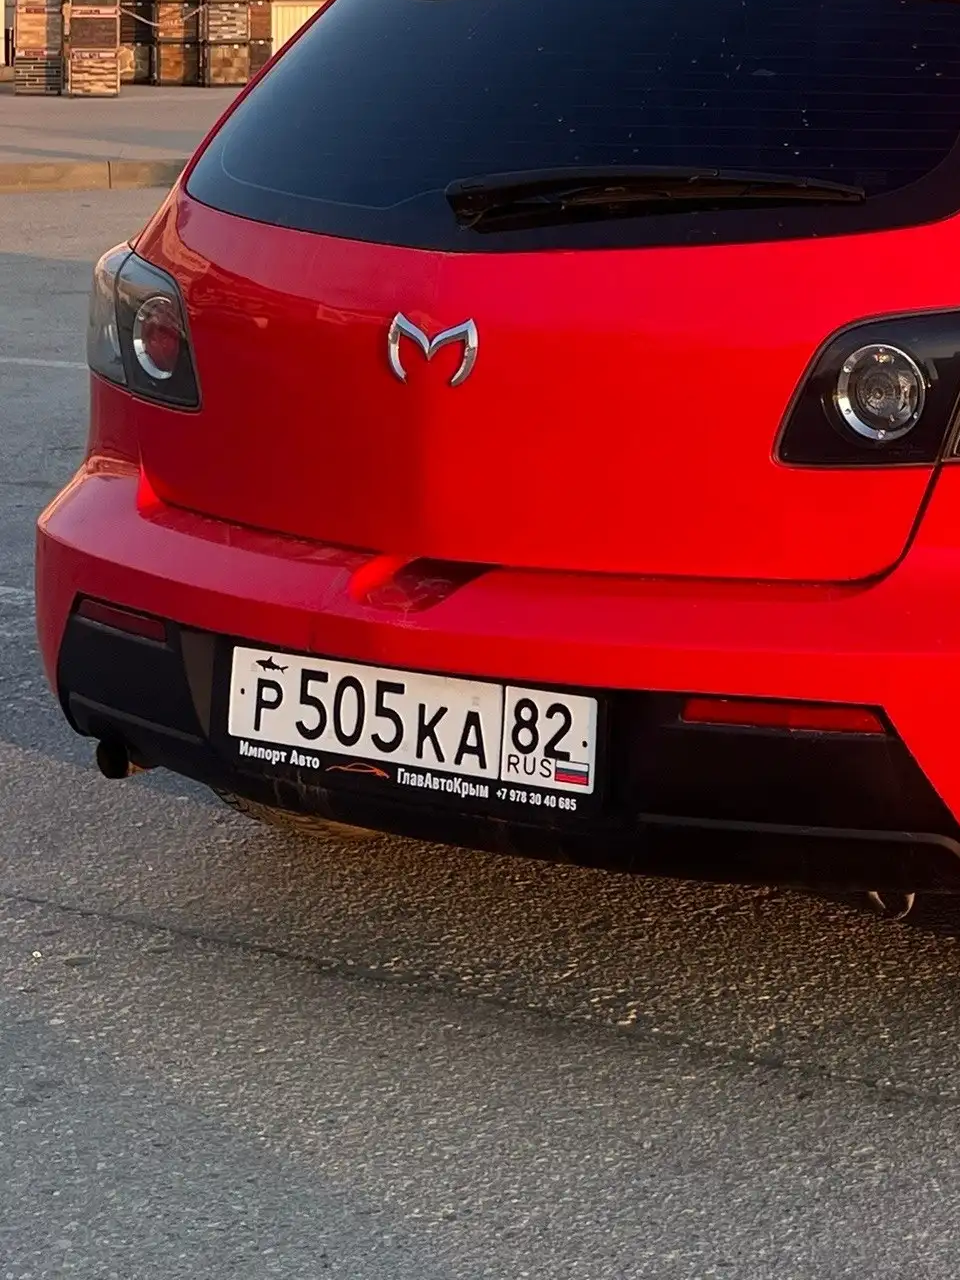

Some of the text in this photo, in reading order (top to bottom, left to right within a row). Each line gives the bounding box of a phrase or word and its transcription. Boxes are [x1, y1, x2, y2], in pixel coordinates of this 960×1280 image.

[511, 698, 573, 761] 82
[238, 740, 577, 811] Импорт Авто ГлавАвтоКрым +7 978 30 40 685
[507, 754, 552, 778] RUS
